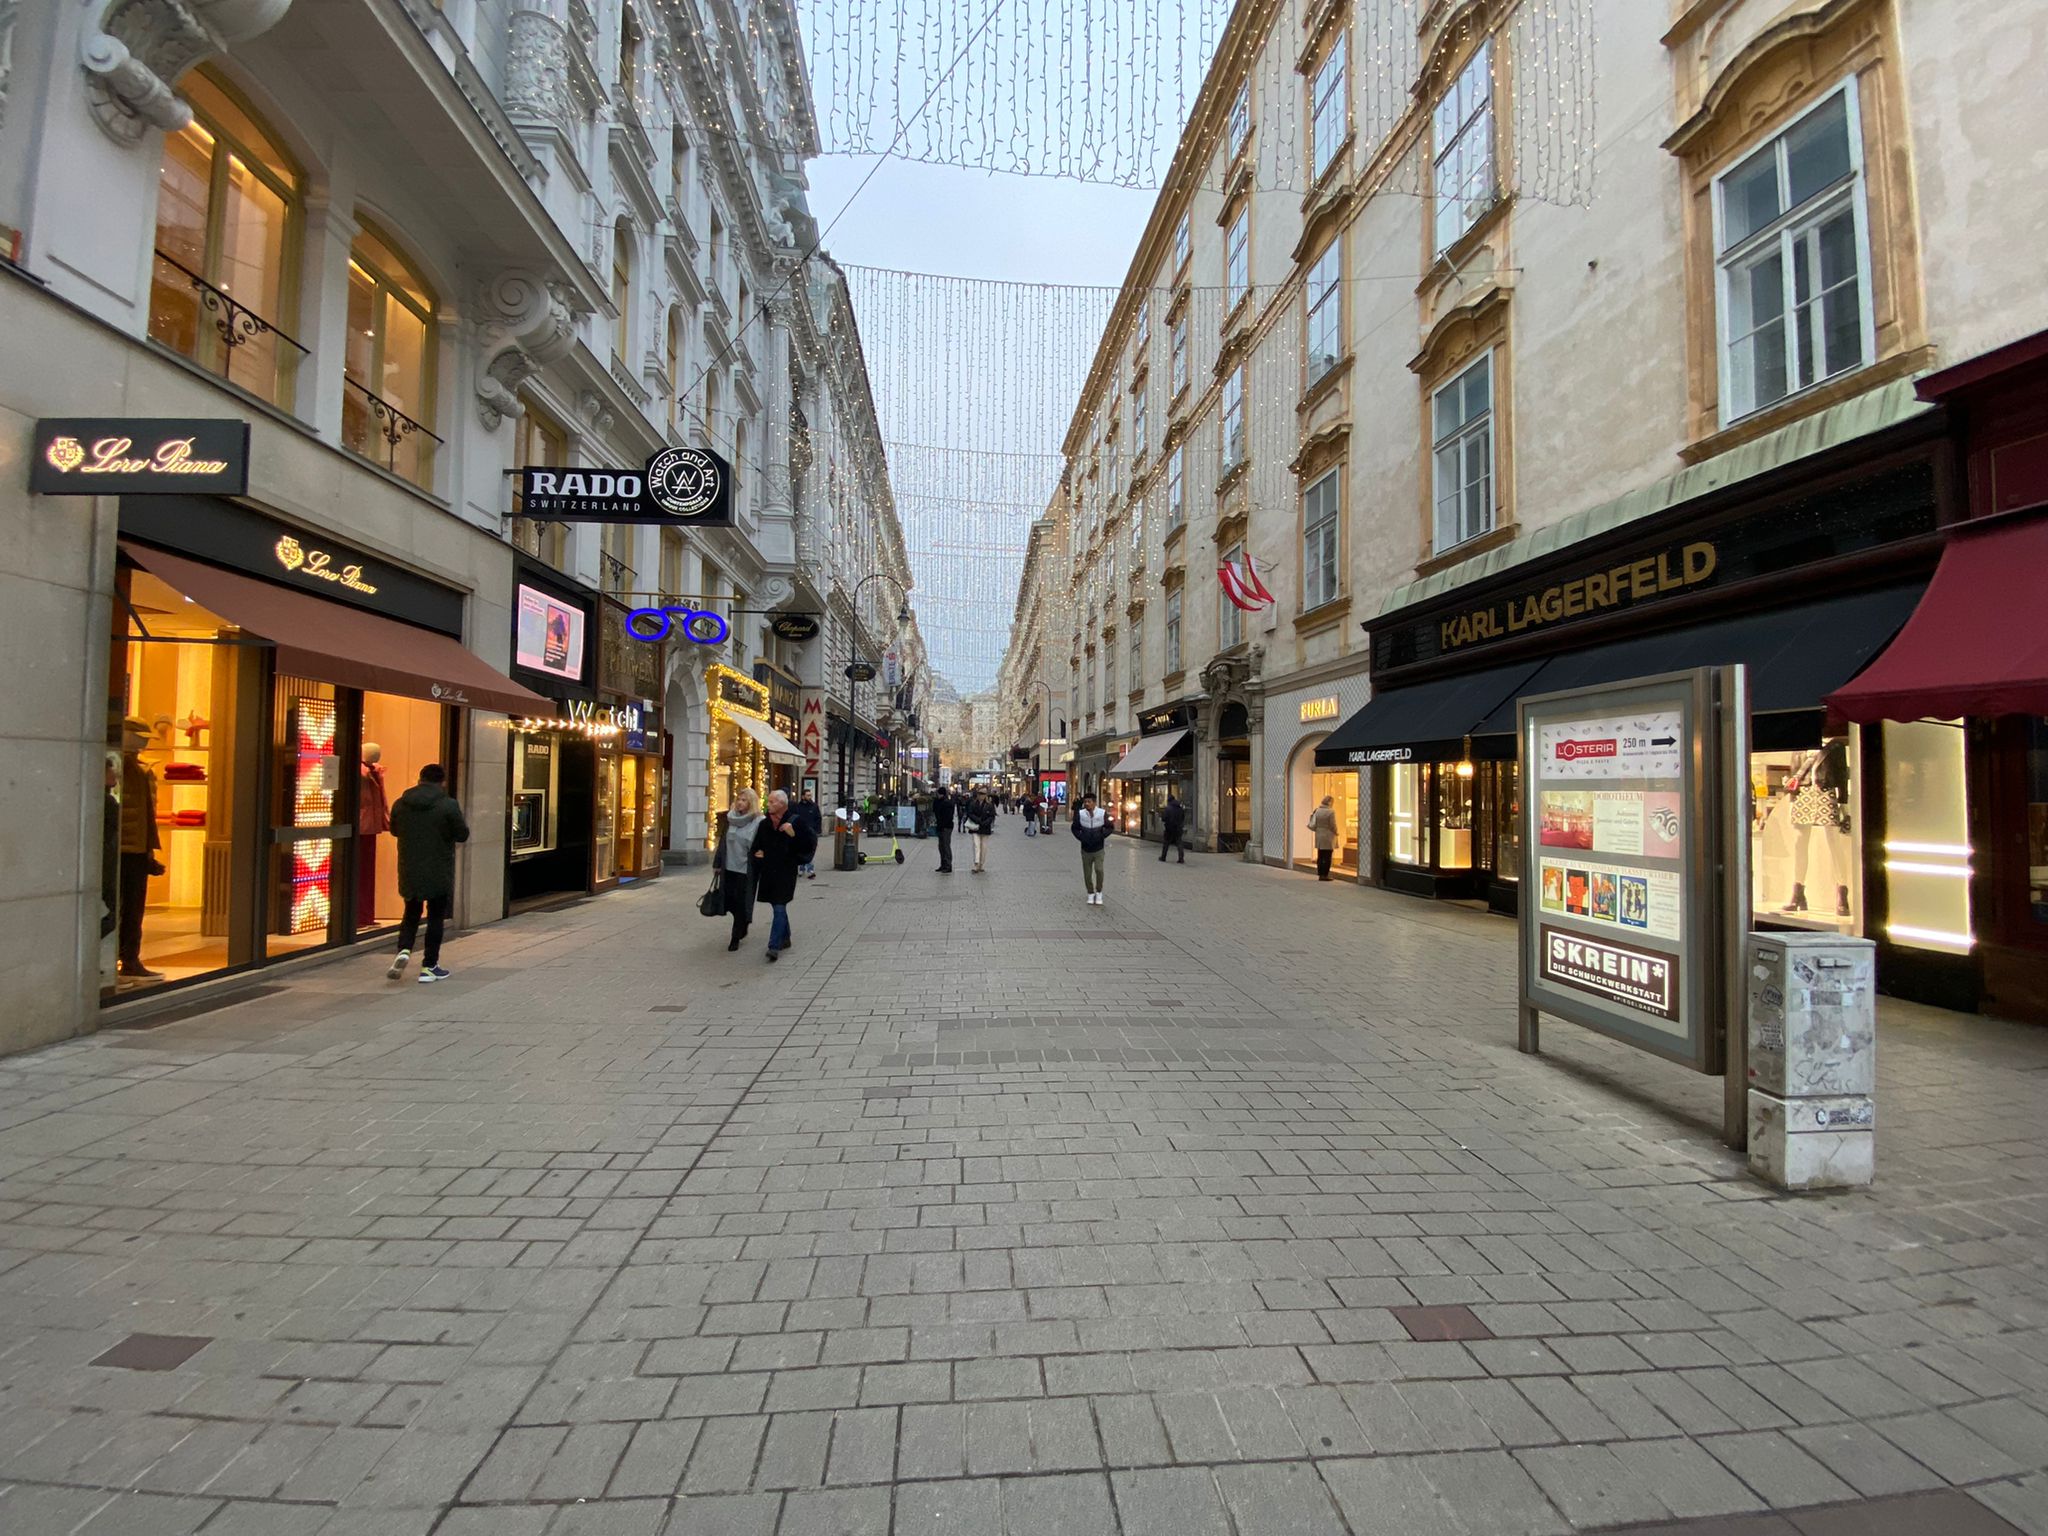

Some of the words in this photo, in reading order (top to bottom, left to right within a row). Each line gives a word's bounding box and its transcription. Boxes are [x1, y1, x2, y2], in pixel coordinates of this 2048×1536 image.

[81, 438, 150, 473] Loro
[151, 437, 227, 473] Piana
[651, 452, 679, 488] Watch
[681, 452, 708, 468] and
[703, 469, 715, 487] Art
[531, 472, 641, 498] RADO
[530, 500, 641, 512] SWITZERLAND
[302, 551, 340, 581] Loro
[340, 565, 377, 594] Piana
[1441, 607, 1504, 650] KARL
[1507, 541, 1717, 633] LAGERFELD
[1301, 698, 1336, 720] FURLA
[527, 743, 549, 755] RADO
[804, 697, 822, 775] MANZ
[1558, 743, 1614, 758] L'OSTERIA
[1623, 738, 1636, 749] 250
[1638, 740, 1646, 748] m
[1348, 751, 1366, 762] KARL
[1366, 748, 1412, 762] LAGERFELD
[1553, 939, 1648, 984] SKREIN
[1553, 962, 1566, 973] DIE
[1568, 967, 1661, 1002] SCHMUCKWERKSTATT
